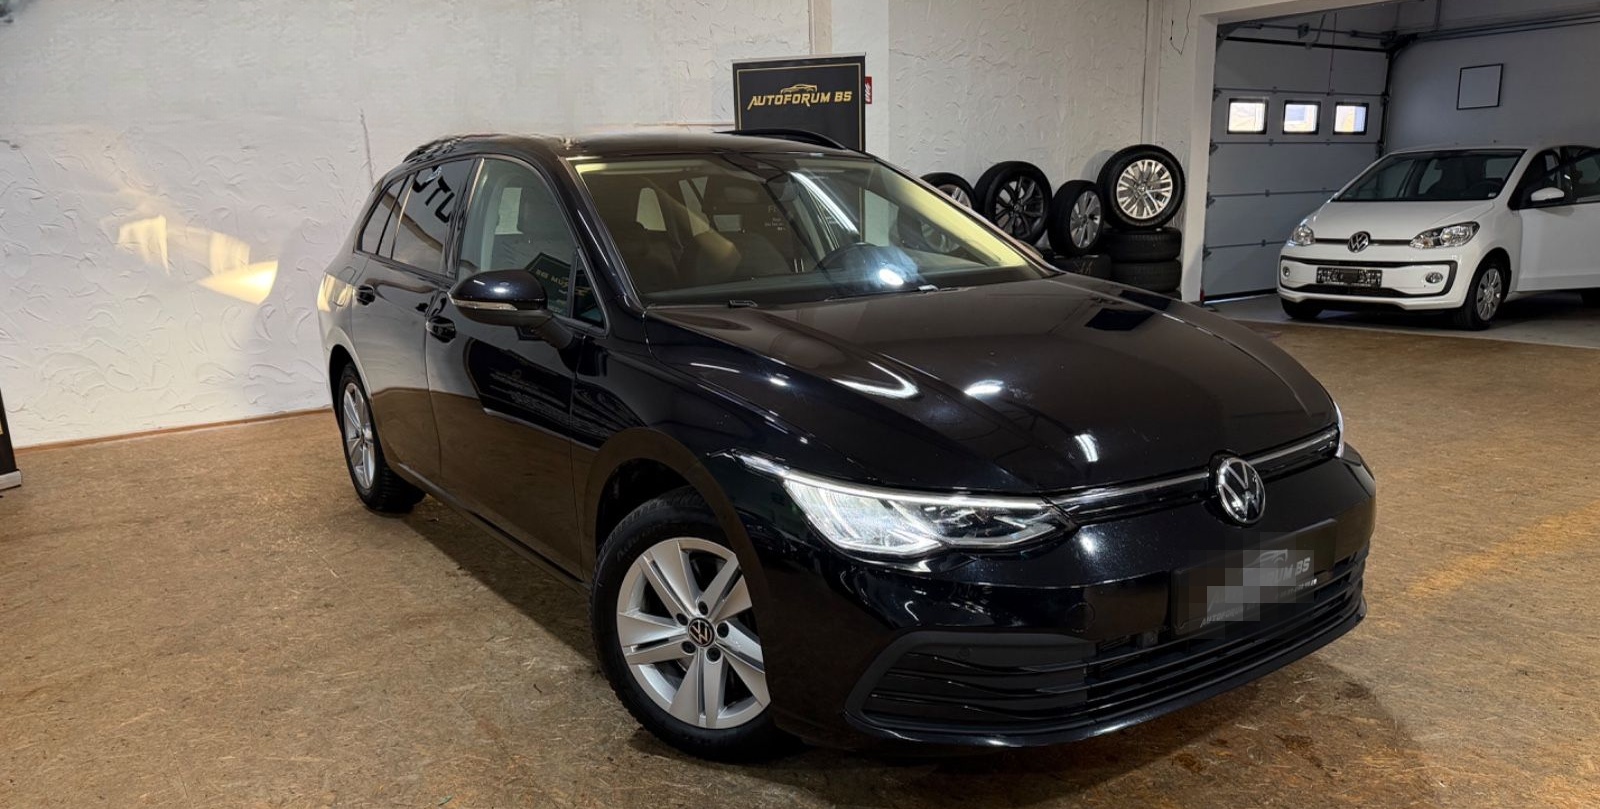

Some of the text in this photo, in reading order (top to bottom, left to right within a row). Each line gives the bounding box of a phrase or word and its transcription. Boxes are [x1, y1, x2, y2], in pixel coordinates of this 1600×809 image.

[747, 92, 831, 110] AUTOFORUM
[834, 91, 853, 102] BS
[1295, 556, 1311, 577] BS
